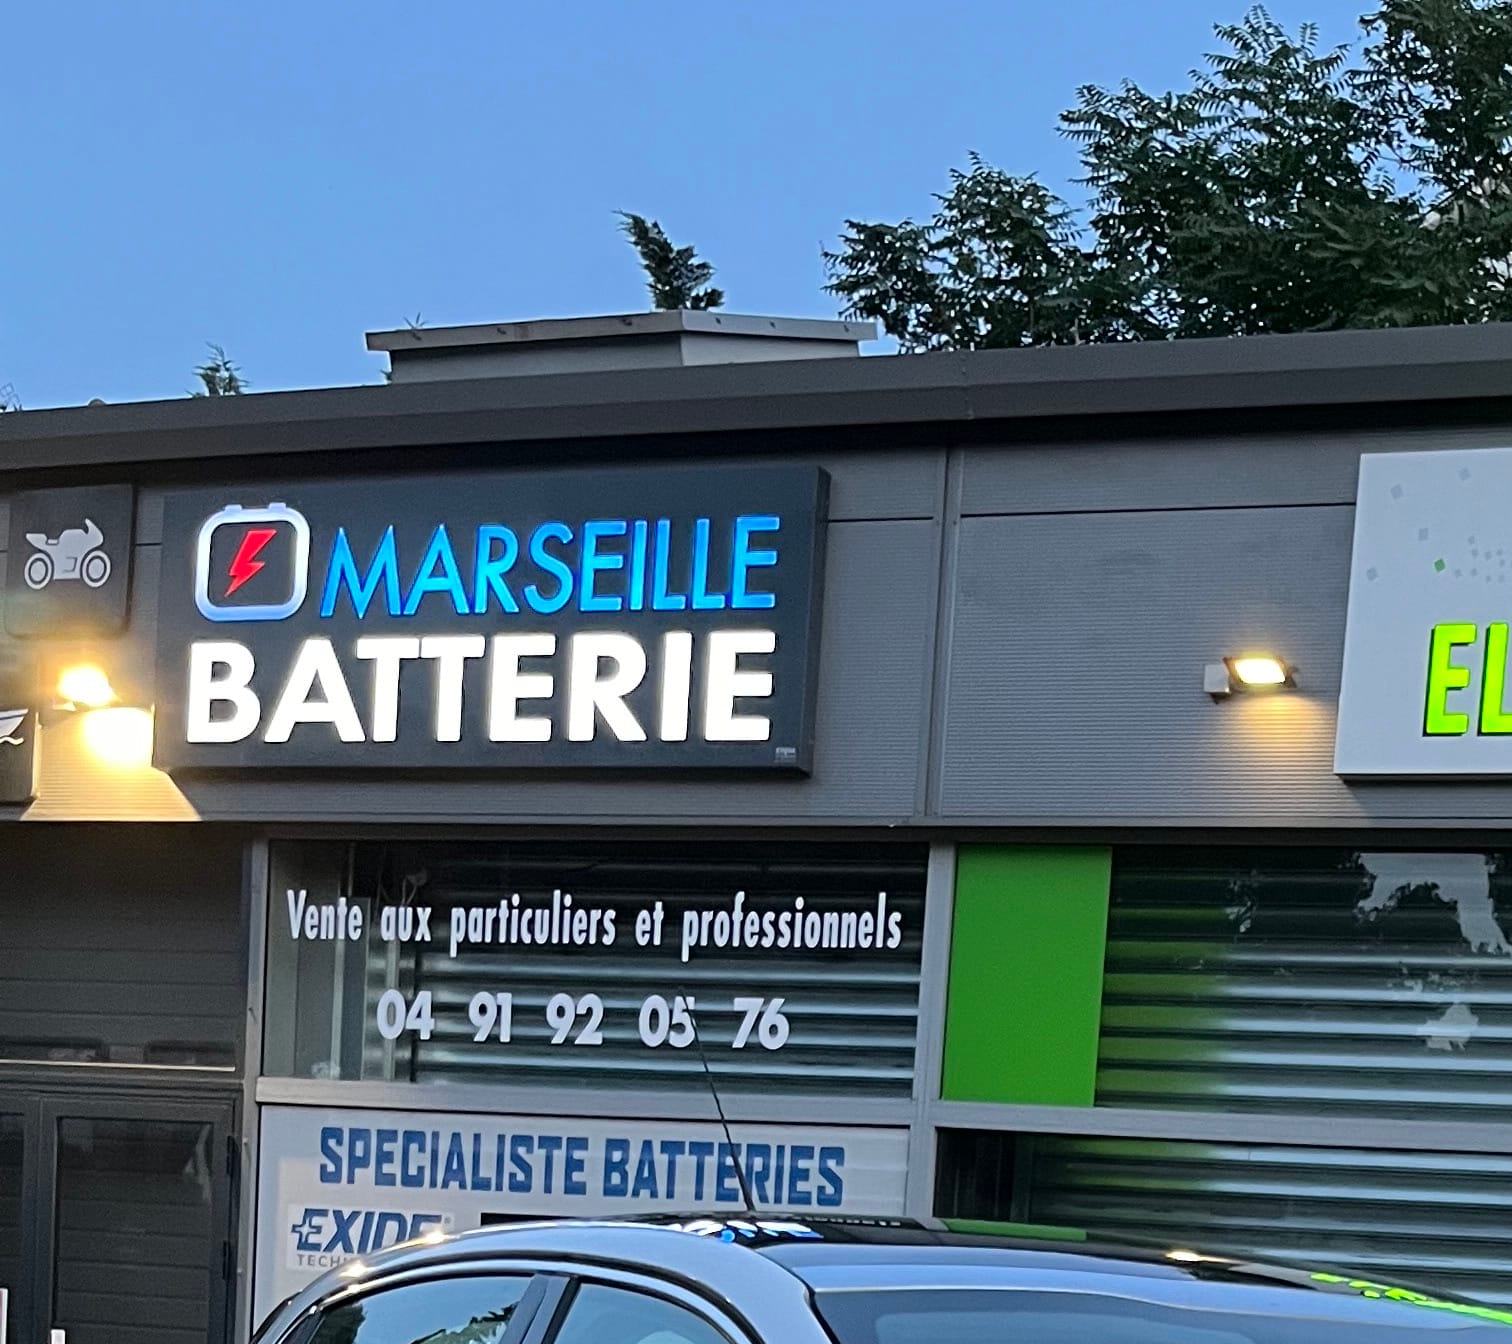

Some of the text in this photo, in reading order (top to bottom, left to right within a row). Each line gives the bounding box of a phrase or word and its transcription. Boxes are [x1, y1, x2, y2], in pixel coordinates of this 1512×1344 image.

[320, 515, 782, 620] MARSEILLE
[185, 628, 778, 745] BATTERIE
[287, 890, 903, 961] Vente aux particuliers et professionnels
[377, 990, 790, 1050] 04 91 92 05 76
[319, 1126, 845, 1207] SPECIALISTE BATTERIES
